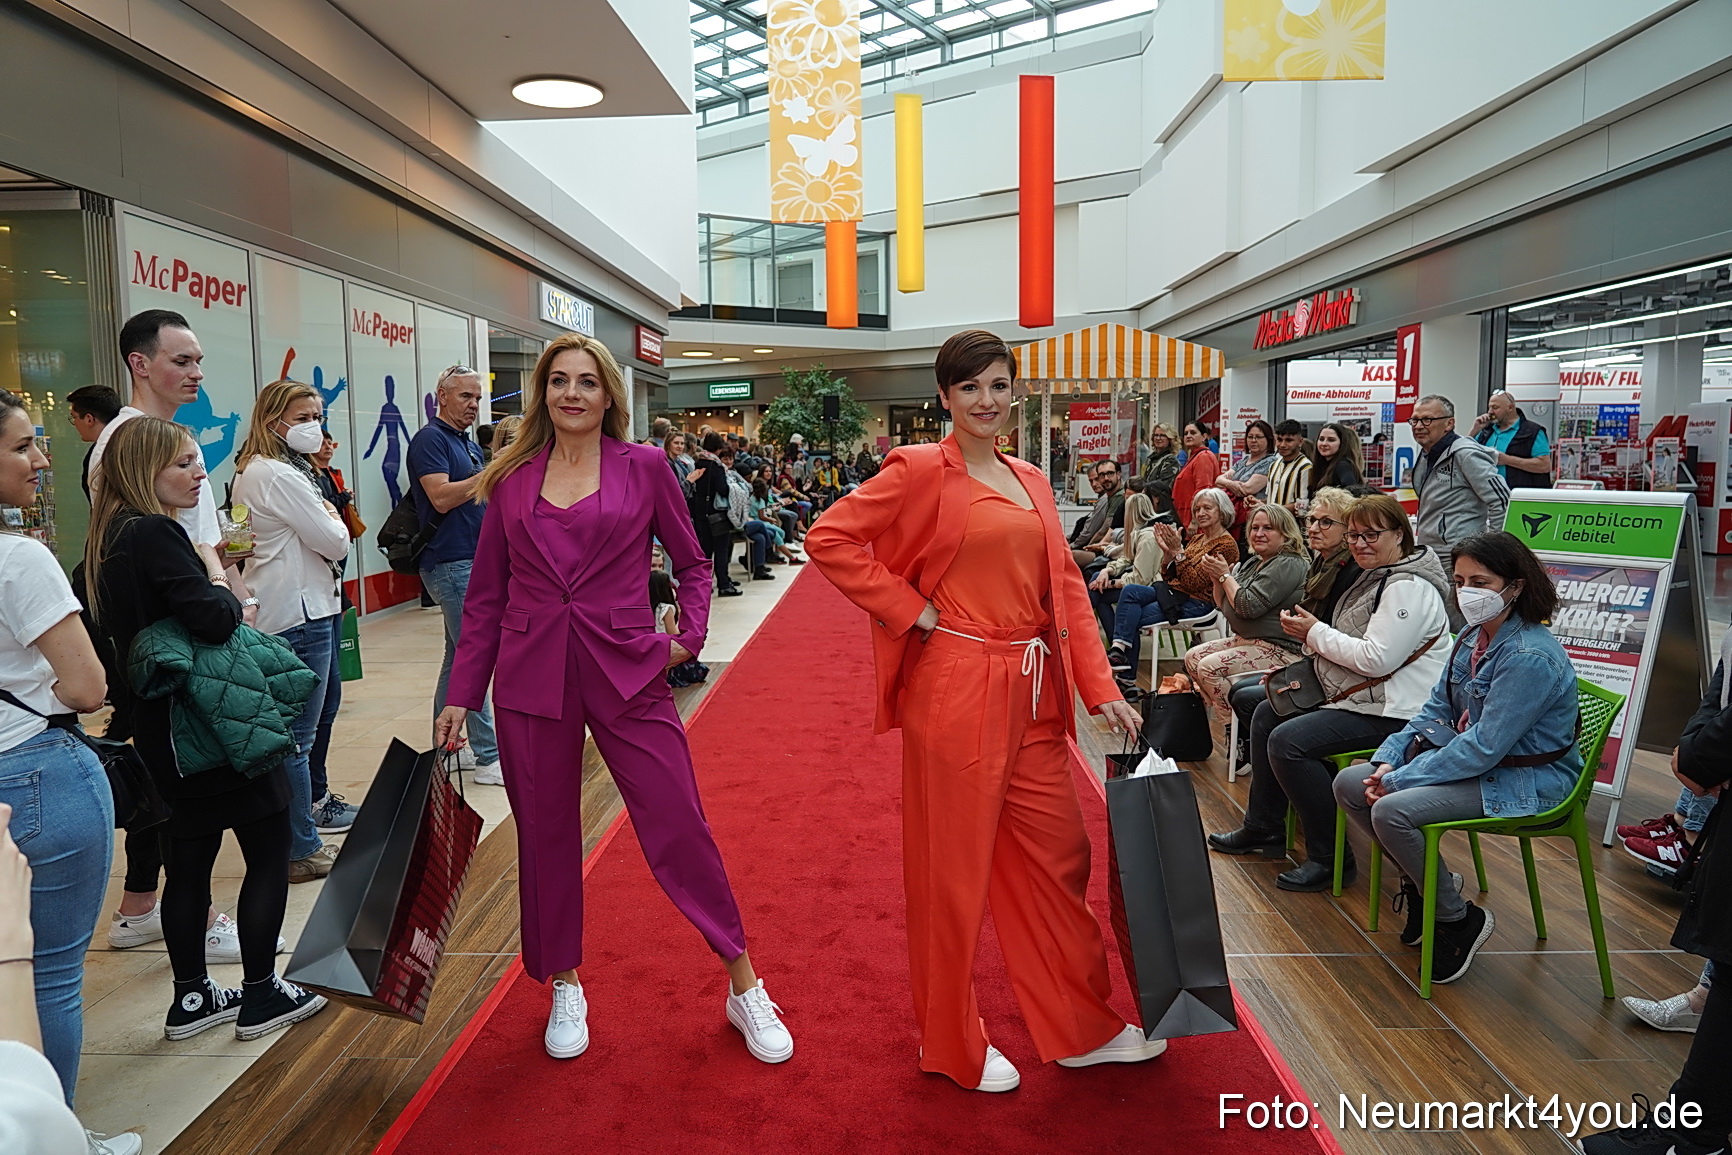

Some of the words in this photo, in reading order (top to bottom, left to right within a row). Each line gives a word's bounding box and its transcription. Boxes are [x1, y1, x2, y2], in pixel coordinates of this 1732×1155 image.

[132, 250, 247, 309] McPaper
[352, 308, 413, 347] McPaper
[1403, 332, 1415, 381] 1
[1362, 366, 1397, 381] KAS
[1560, 371, 1606, 386] MUSIK
[1619, 371, 1642, 386] FIL
[712, 387, 748, 395] LEBENSRAUM
[1291, 389, 1372, 400] Online-Abholung
[1566, 512, 1663, 529] mobilcom
[1562, 528, 1616, 544] debitel
[1556, 580, 1650, 607] ENERGIE
[1555, 607, 1635, 633] KRISE?
[1573, 638, 1621, 651] VERGLEICH!
[1593, 664, 1629, 675] Mitbewerber,
[1606, 674, 1632, 682] gängiges
